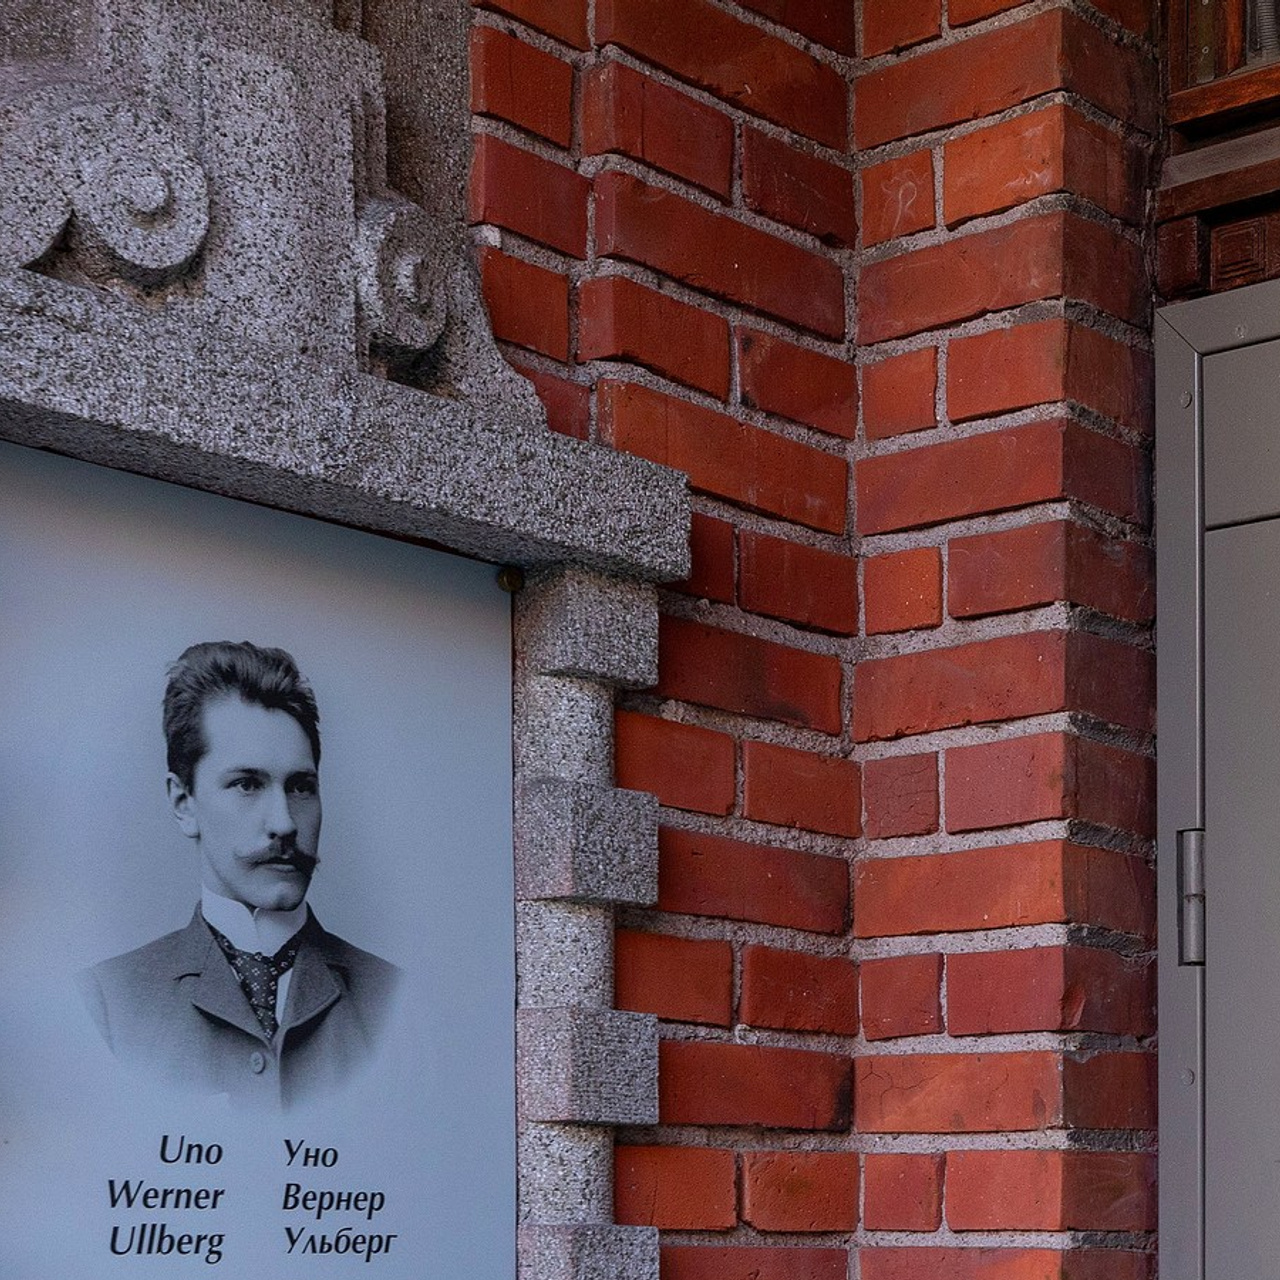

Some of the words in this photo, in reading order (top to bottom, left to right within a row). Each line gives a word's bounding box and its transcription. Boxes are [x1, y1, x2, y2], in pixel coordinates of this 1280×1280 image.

[159, 1134, 223, 1165] Uno
[283, 1138, 339, 1168] Уно
[106, 1179, 226, 1210] Werner
[282, 1182, 386, 1220] Вернер
[109, 1223, 226, 1264] Ullberg
[284, 1226, 398, 1263] Ульберг
